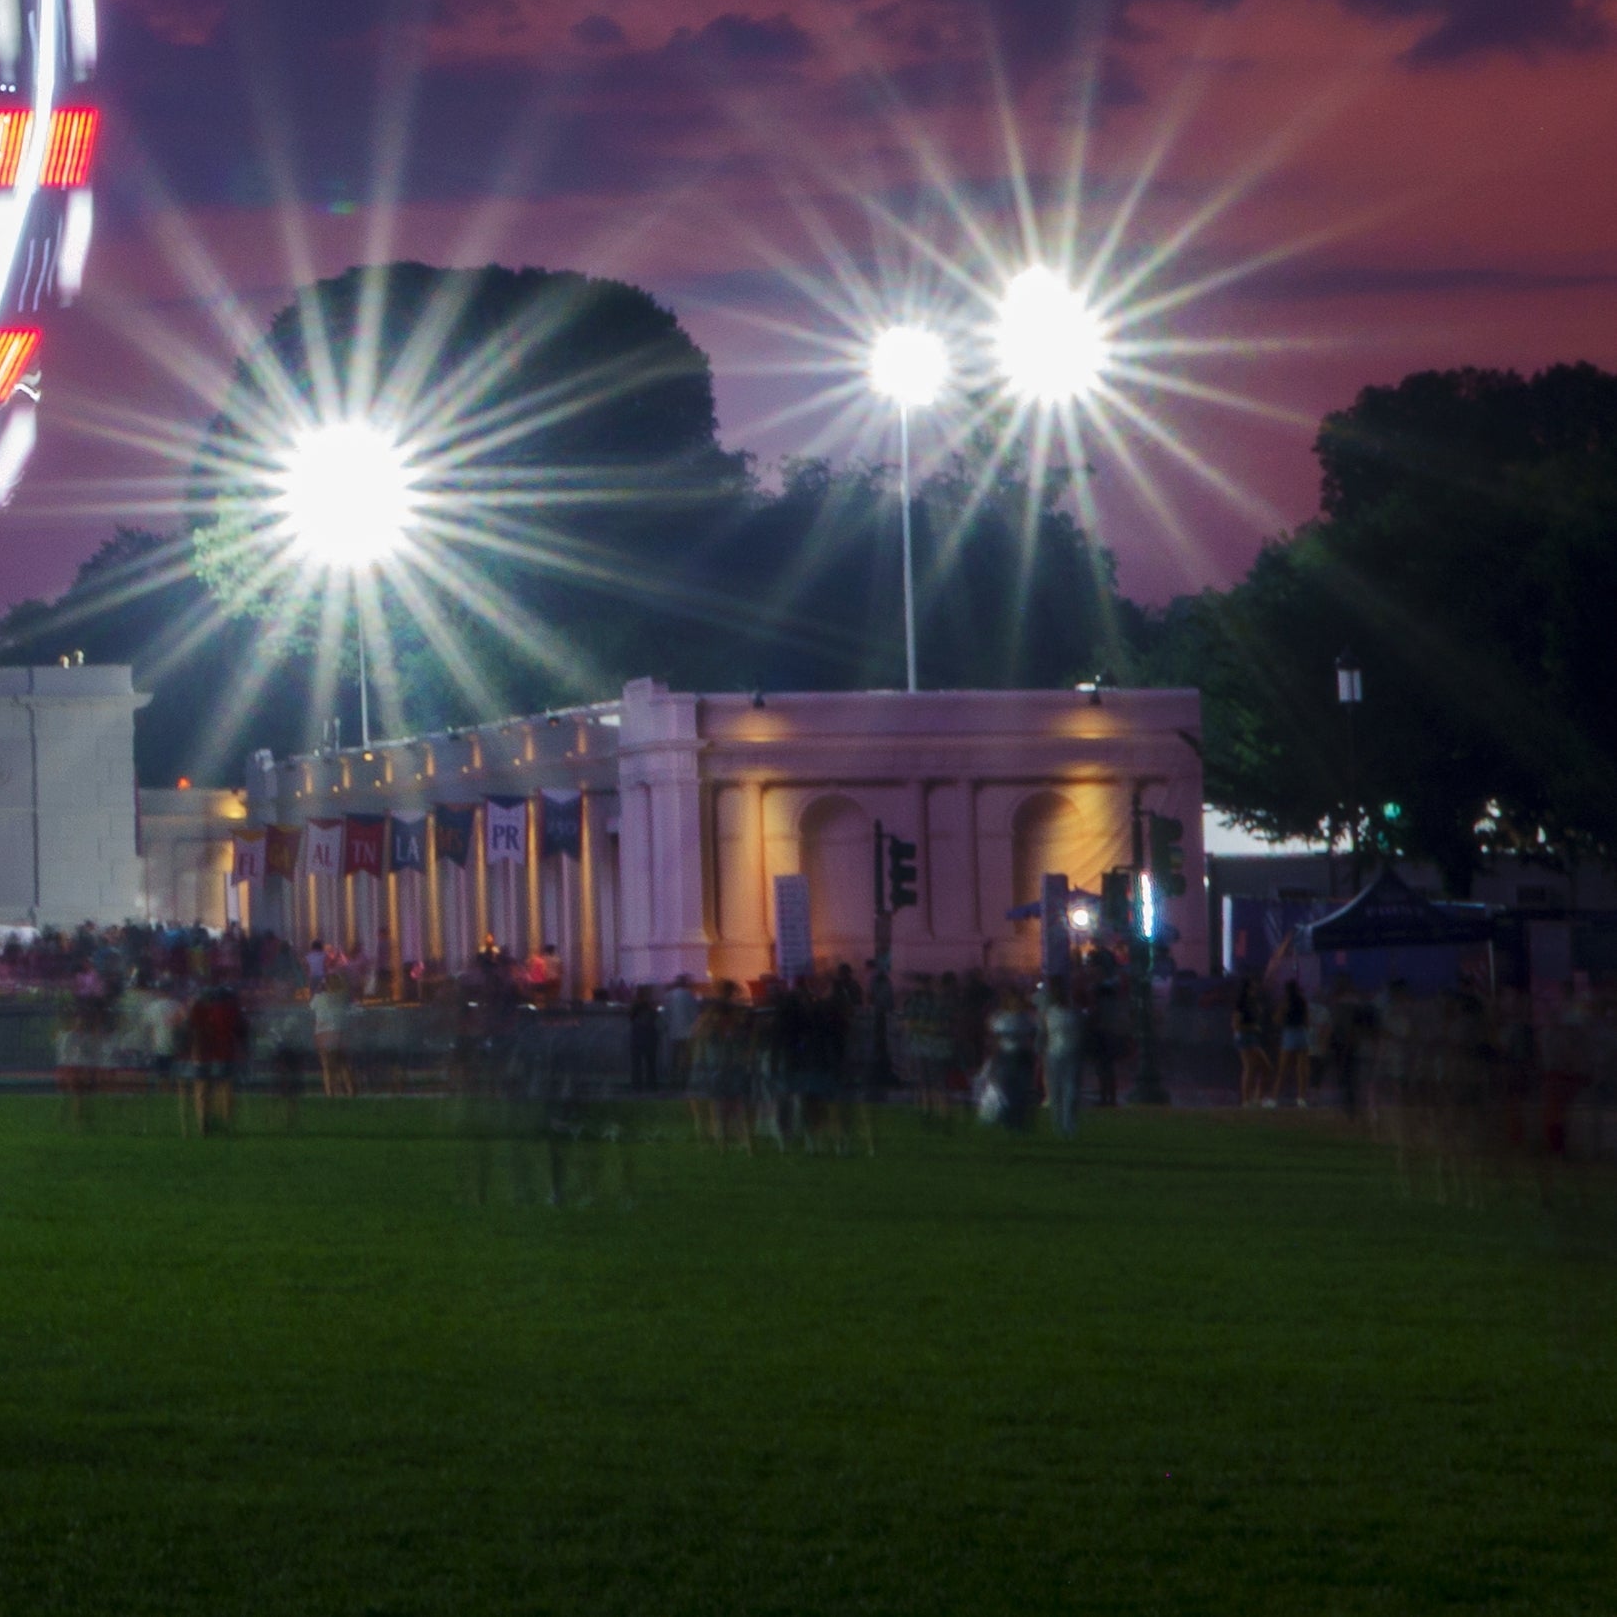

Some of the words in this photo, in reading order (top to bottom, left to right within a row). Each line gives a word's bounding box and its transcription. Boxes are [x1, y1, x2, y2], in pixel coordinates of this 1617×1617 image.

[395, 835, 420, 862] LA
[492, 824, 520, 851] PR
[311, 842, 334, 867] AL
[352, 840, 378, 864] TN
